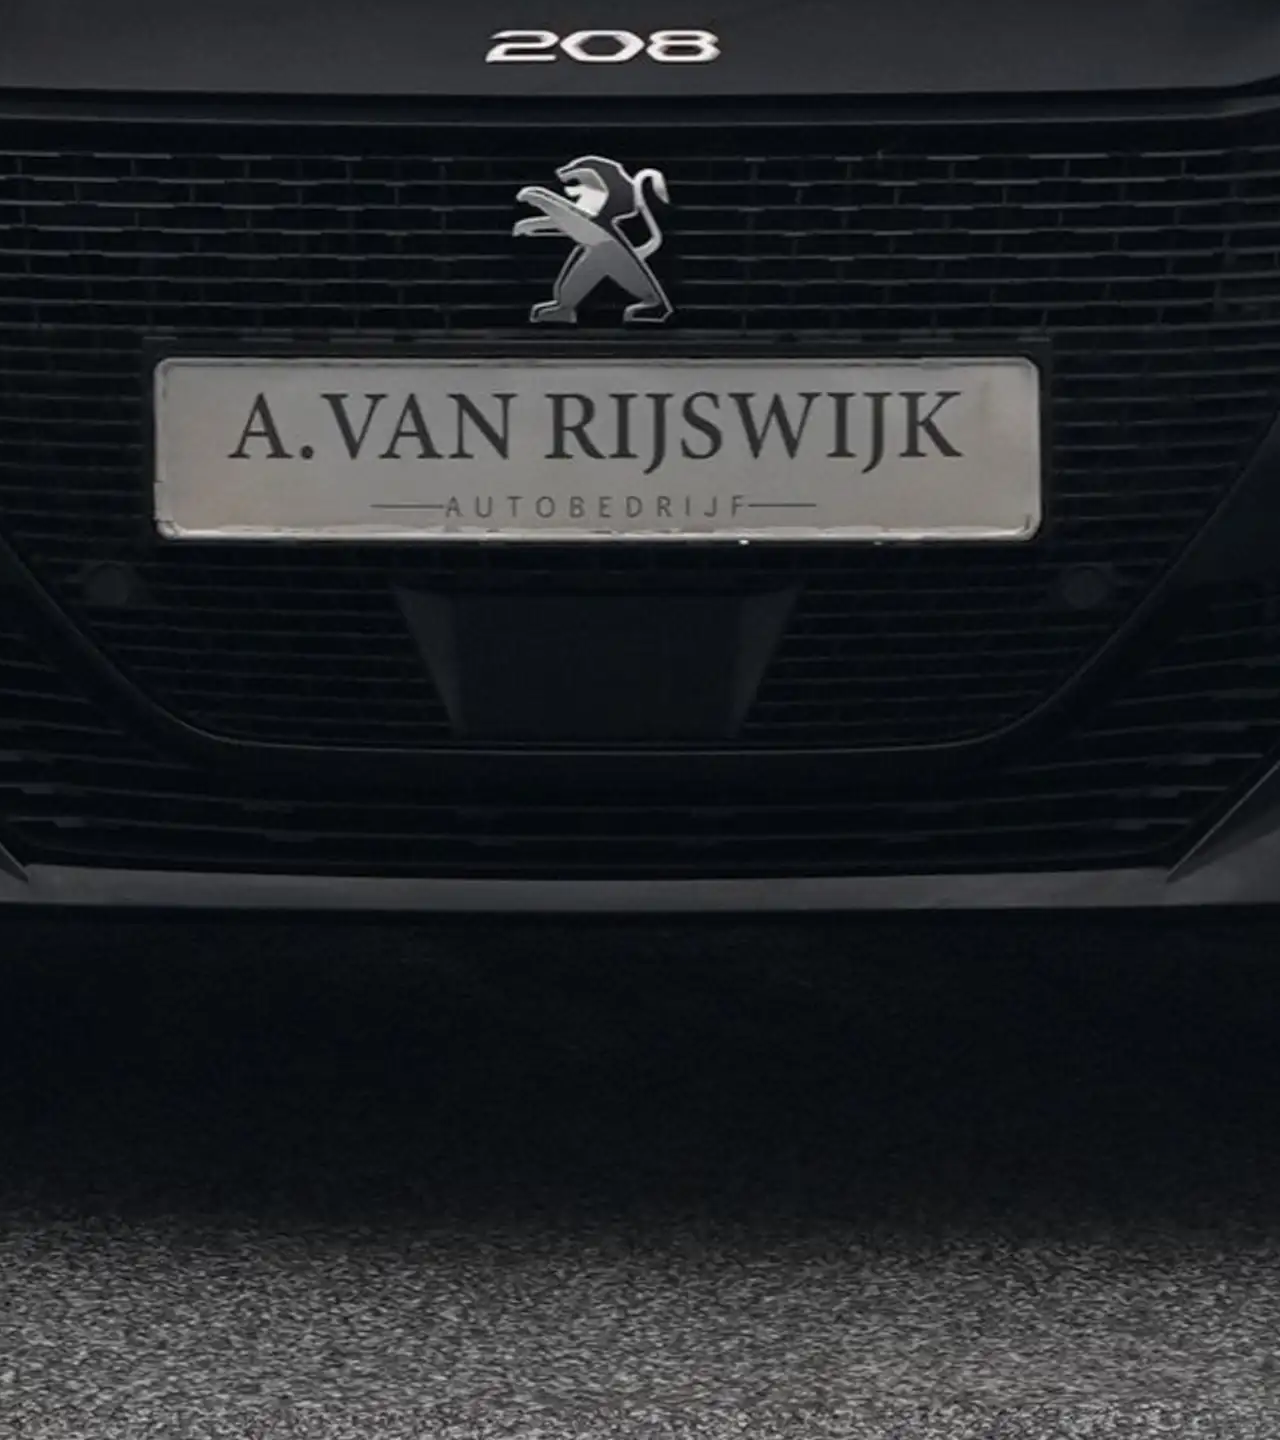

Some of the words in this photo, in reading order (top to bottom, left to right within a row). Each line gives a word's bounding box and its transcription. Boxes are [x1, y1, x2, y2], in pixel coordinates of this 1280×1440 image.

[484, 29, 722, 63] 208
[227, 392, 519, 460] A.VAN
[544, 390, 963, 475] RIJSWIJK
[445, 494, 746, 519] AUTOBEDRIJF
